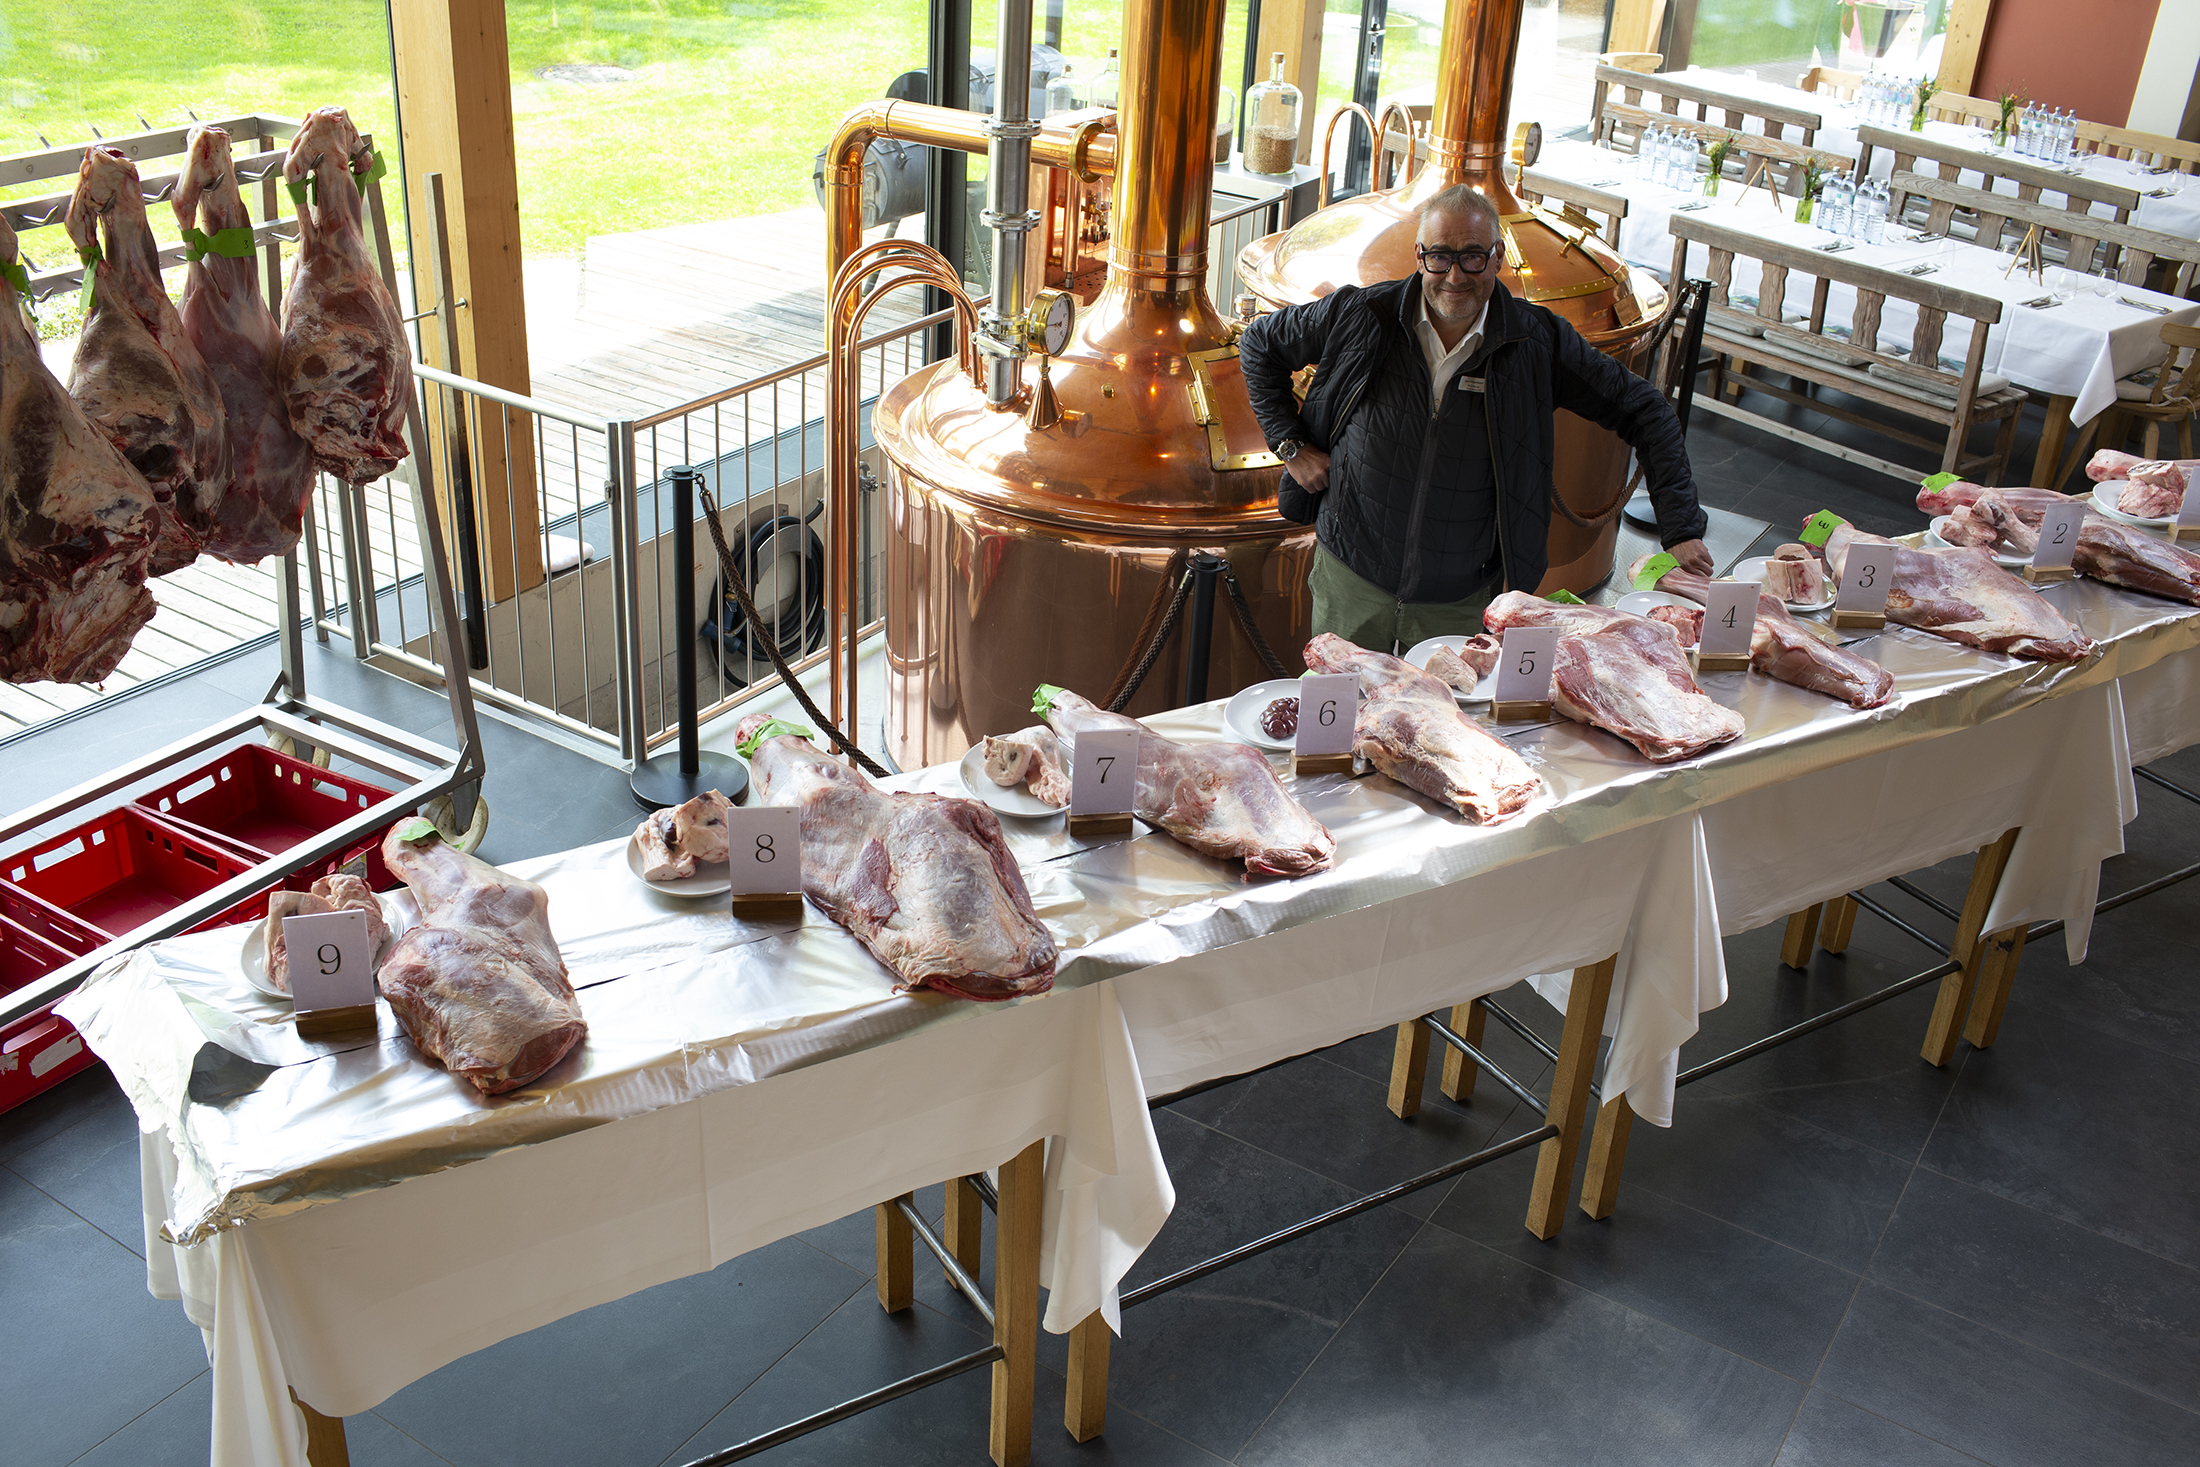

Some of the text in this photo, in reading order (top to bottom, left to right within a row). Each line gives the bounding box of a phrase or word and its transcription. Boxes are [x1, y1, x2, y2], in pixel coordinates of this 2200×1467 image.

[2052, 523, 2068, 545] 2
[1858, 565, 1876, 588] 3
[1721, 605, 1737, 629] 4
[1518, 650, 1536, 676] 5
[1318, 700, 1337, 727] 6
[1096, 756, 1116, 785] 7
[755, 834, 777, 864] 8
[316, 943, 342, 976] 9
